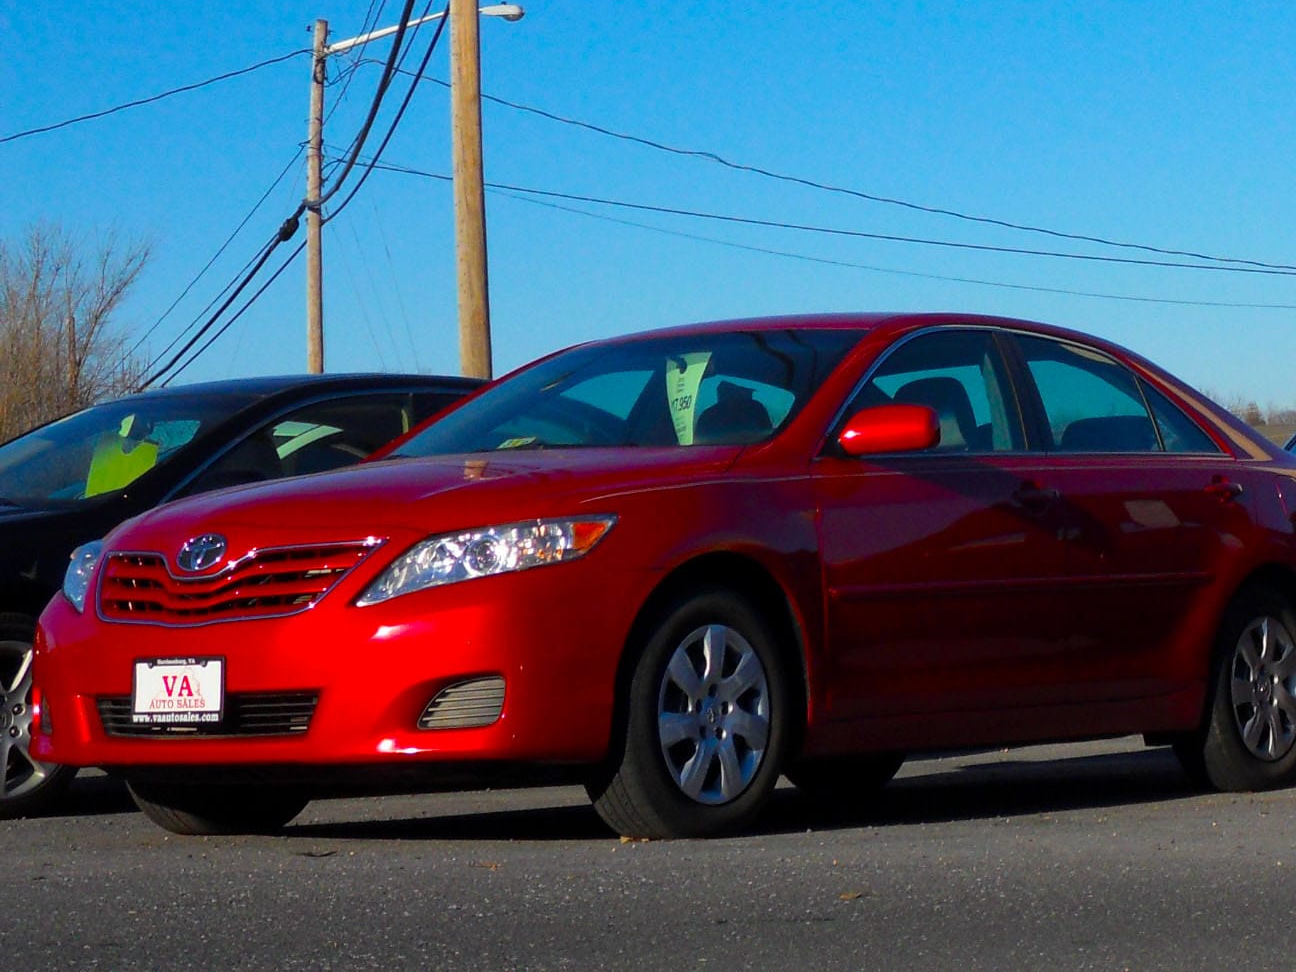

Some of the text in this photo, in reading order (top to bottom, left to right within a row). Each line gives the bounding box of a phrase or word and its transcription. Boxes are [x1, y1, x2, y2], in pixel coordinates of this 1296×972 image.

[162, 675, 193, 697] VA
[150, 699, 205, 708] AUTO SALES
